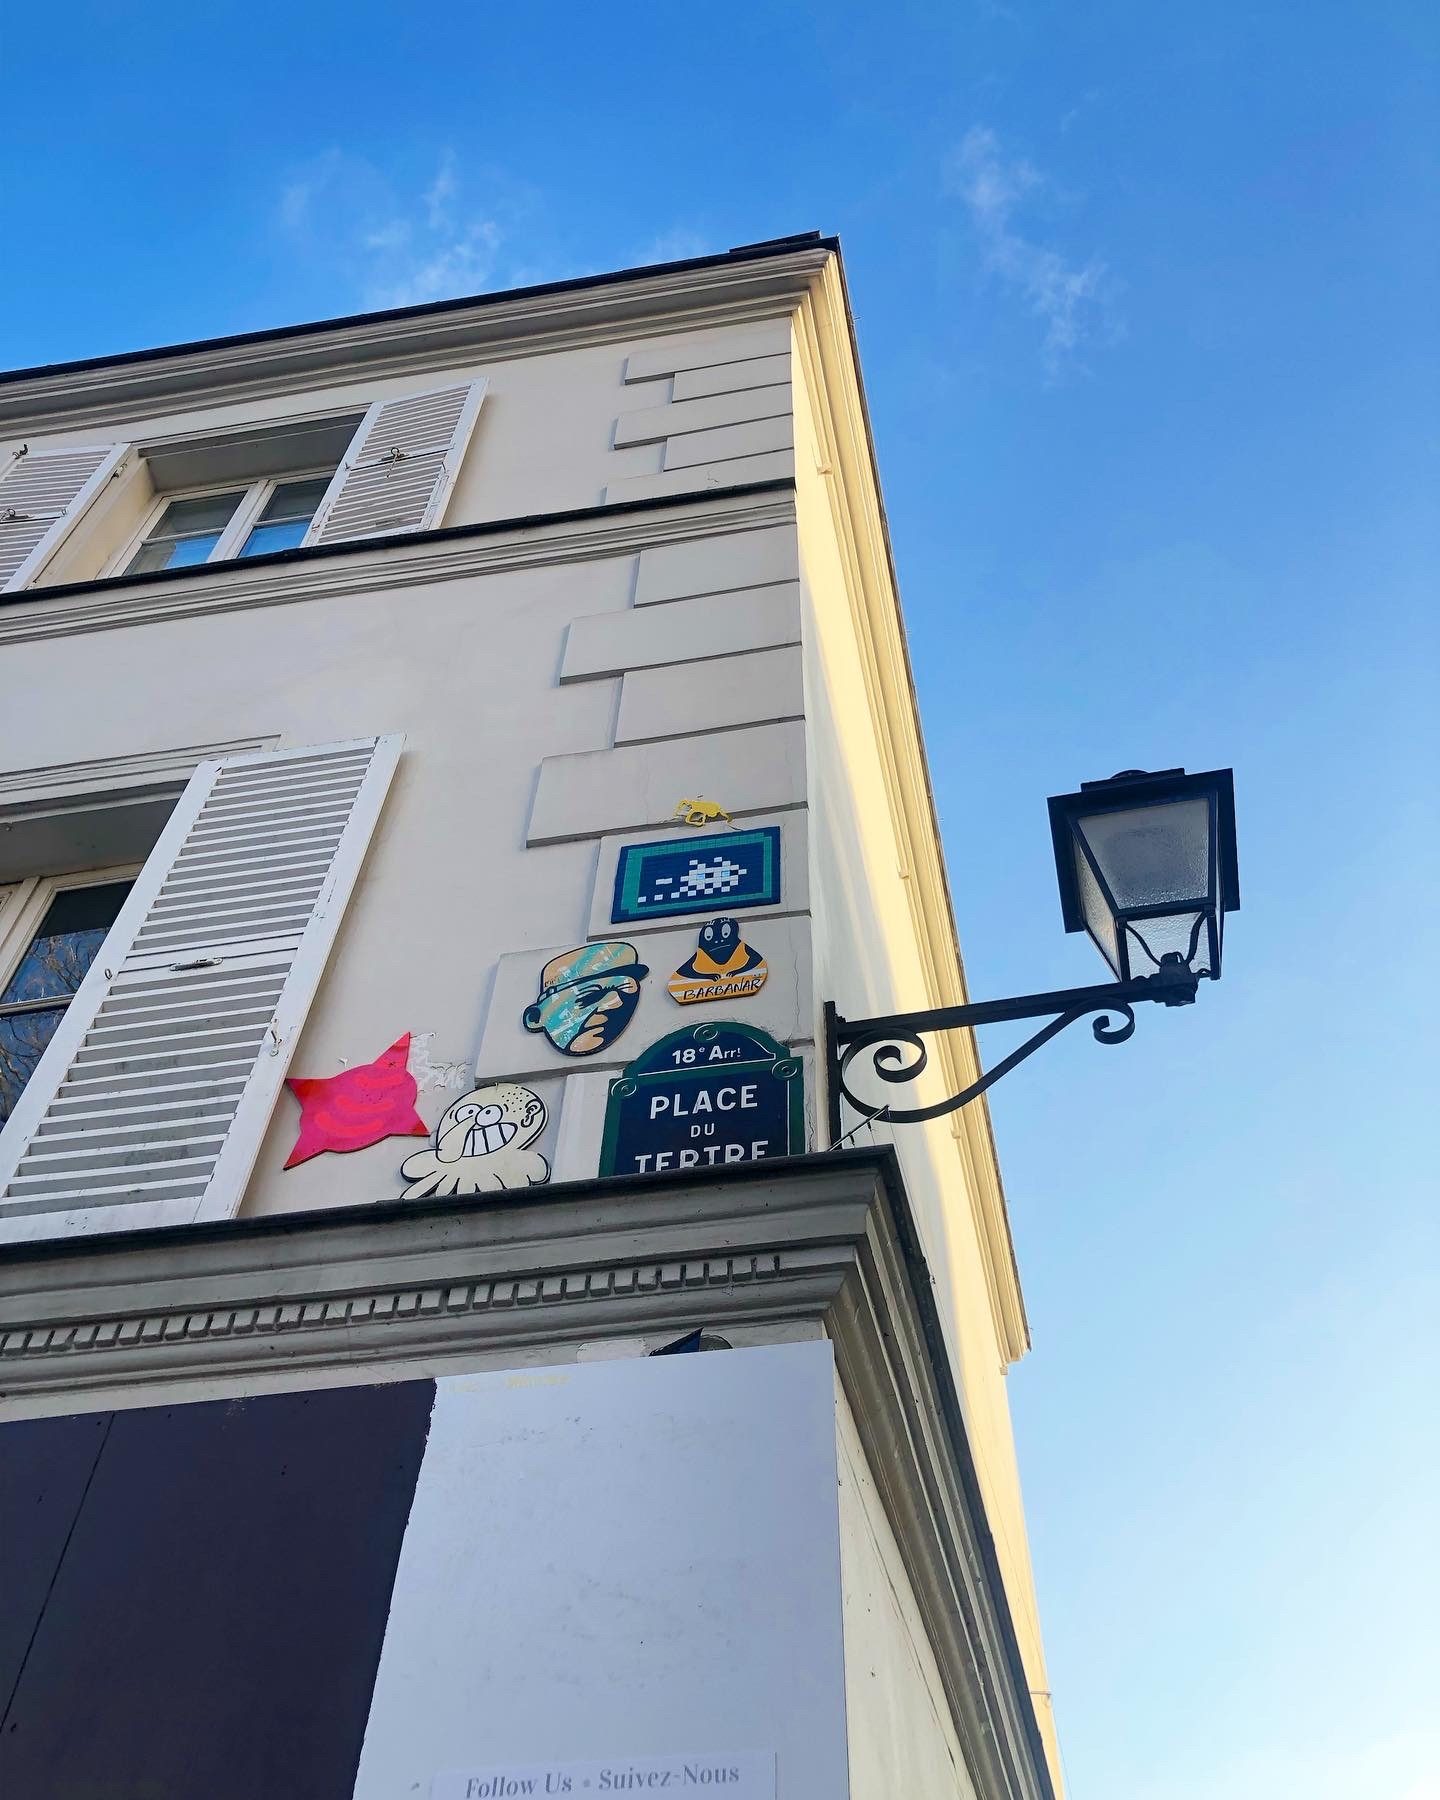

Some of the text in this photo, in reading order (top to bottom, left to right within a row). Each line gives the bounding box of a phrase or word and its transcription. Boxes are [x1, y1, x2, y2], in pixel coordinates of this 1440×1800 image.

[650, 1084, 758, 1119] PLACE
[690, 1122, 715, 1138] DU
[634, 1140, 769, 1173] TERTRE
[466, 1763, 740, 1799] Follow Us Suivez-Nous
